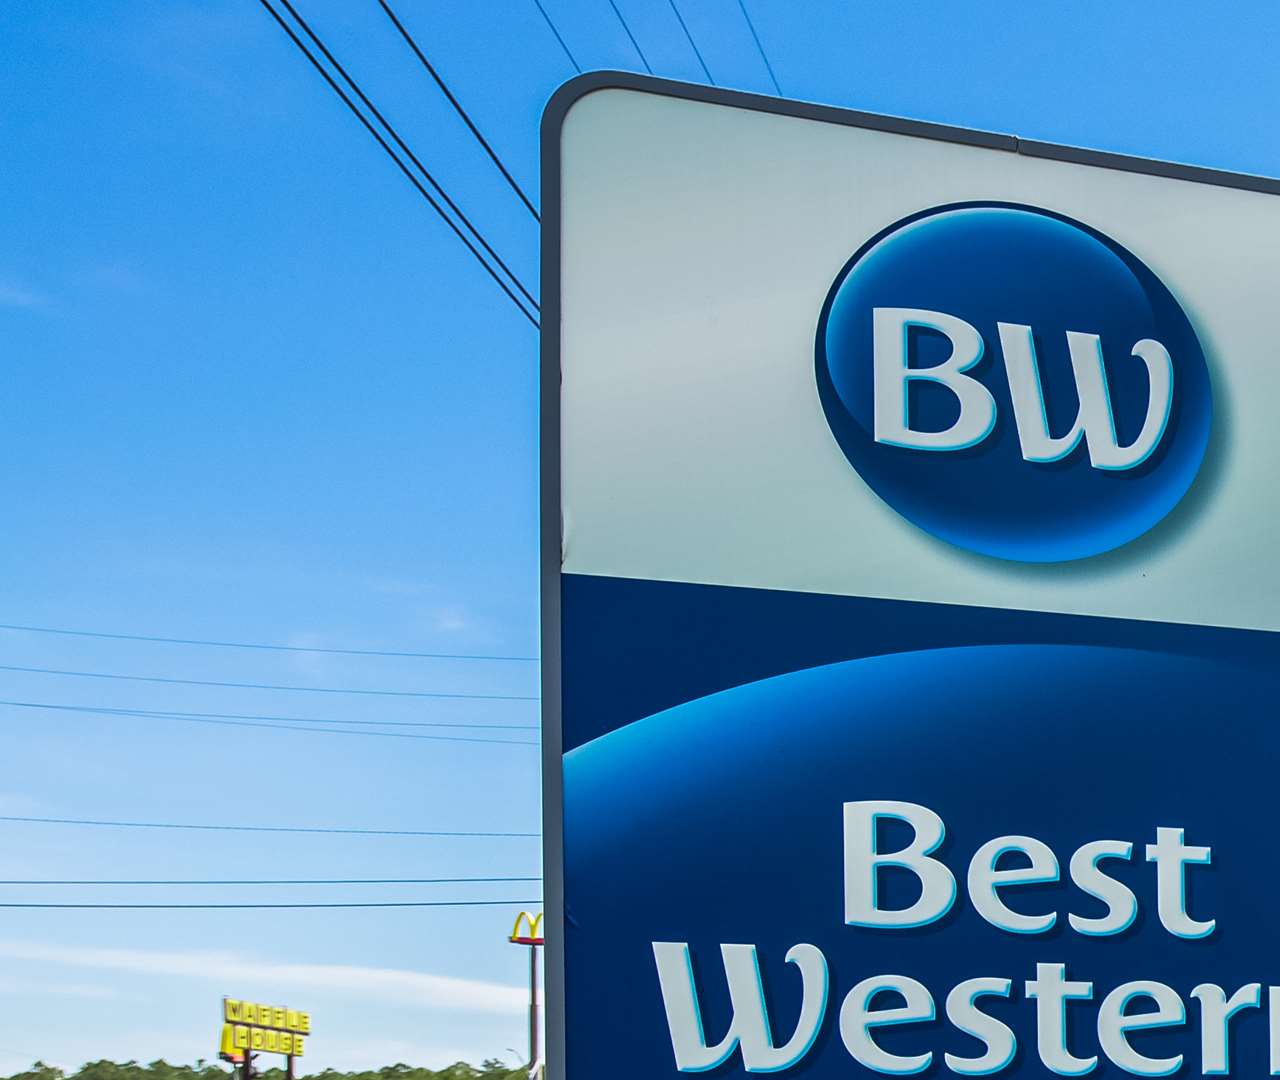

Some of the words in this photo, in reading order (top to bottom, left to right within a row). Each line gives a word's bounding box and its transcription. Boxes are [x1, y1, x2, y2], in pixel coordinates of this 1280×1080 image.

[873, 307, 1174, 471] BW
[843, 800, 1216, 939] Best
[226, 1001, 310, 1031] WAFFLE
[236, 1027, 304, 1054] HOUSE
